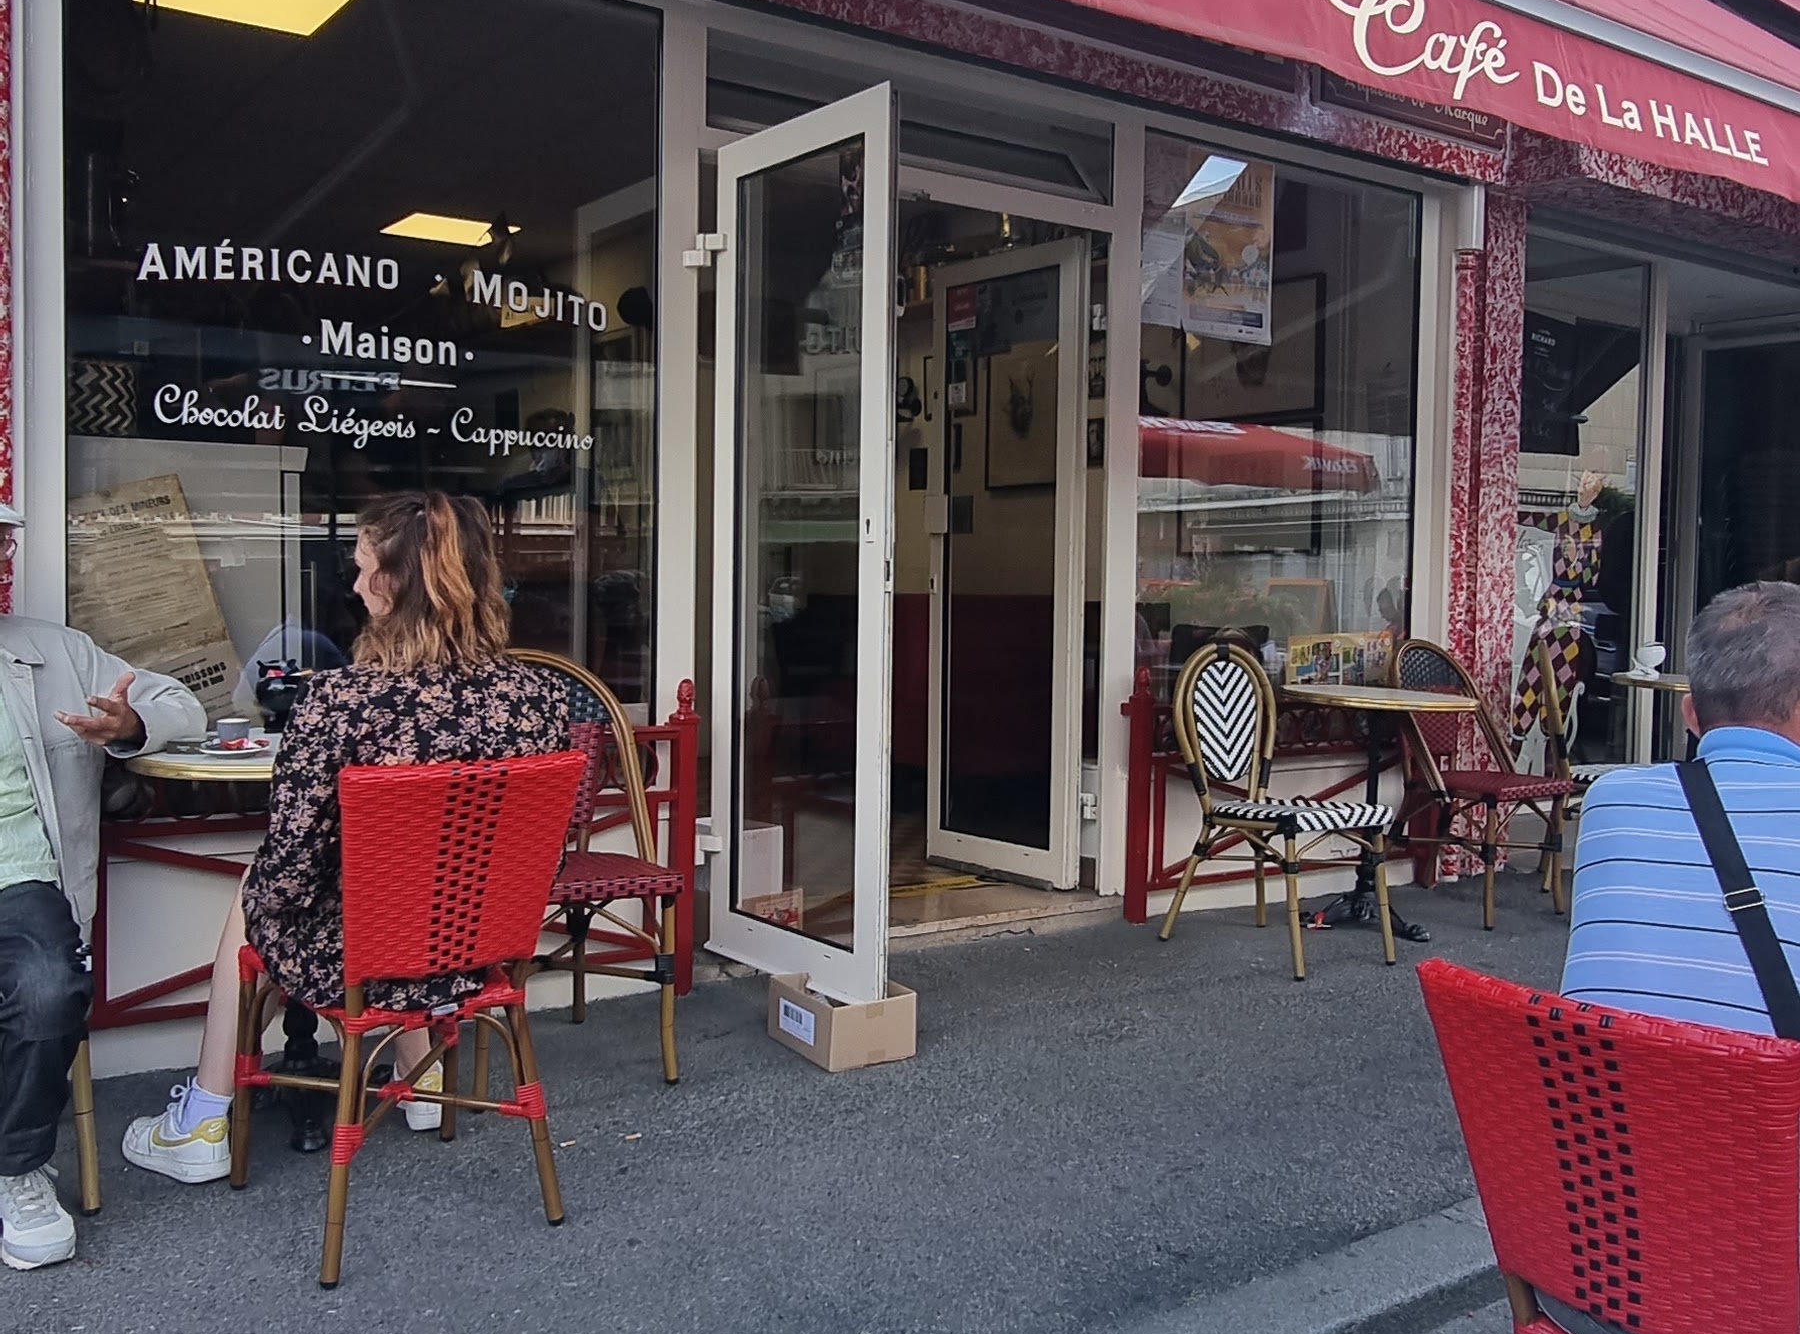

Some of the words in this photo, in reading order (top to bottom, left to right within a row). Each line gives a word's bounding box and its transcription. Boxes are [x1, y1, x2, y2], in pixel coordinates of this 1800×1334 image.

[1532, 61, 1586, 117] De
[1594, 83, 1642, 133] La
[1655, 102, 1769, 167] HALLE
[136, 238, 400, 290] AMÉRICANO
[472, 269, 608, 333] MOJITO
[319, 319, 457, 366] Maison
[154, 384, 286, 431] Chocolat
[298, 395, 417, 450] Liégeois
[451, 408, 595, 456] Cappuccino
